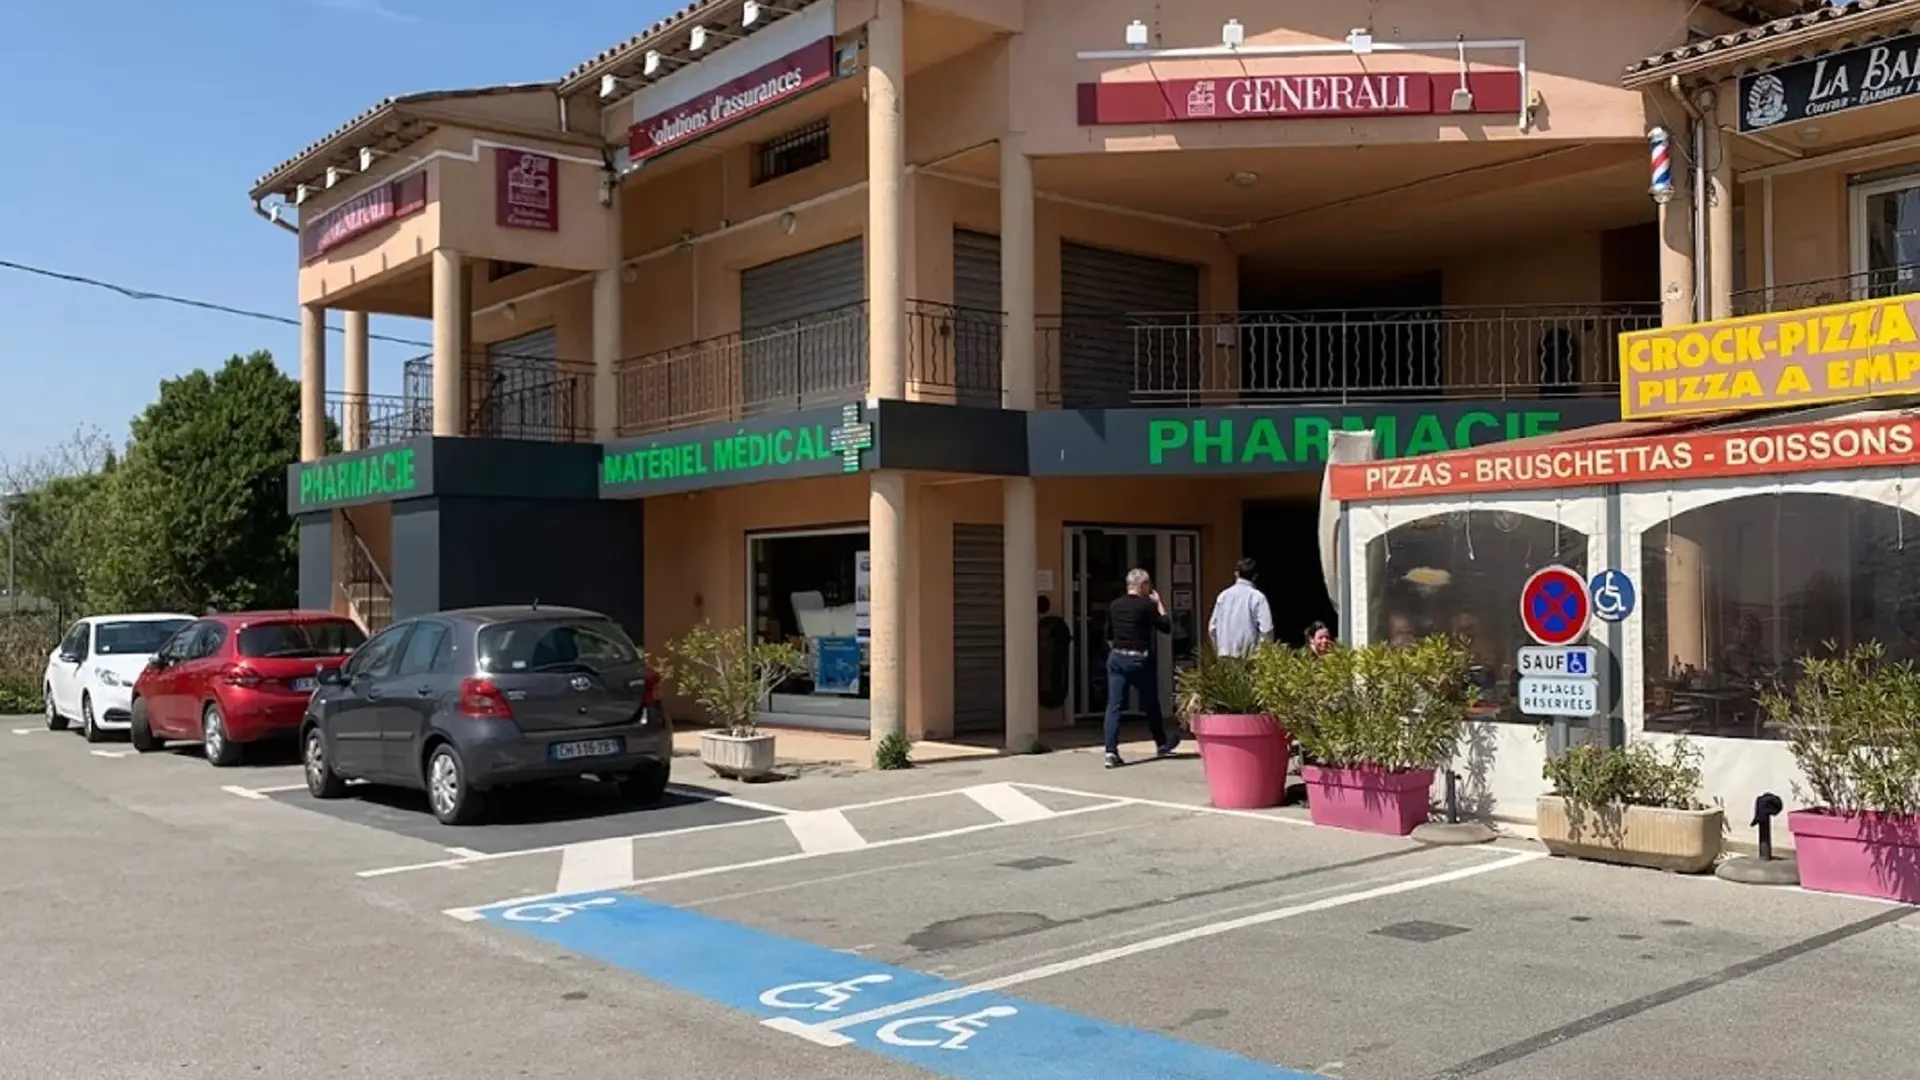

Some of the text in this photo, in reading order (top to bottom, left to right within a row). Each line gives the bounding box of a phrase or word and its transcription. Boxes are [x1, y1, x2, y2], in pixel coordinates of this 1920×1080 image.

[1226, 75, 1409, 113] GENERALI
[1808, 60, 1849, 100] LA
[648, 67, 802, 146] Solutions d'assurances
[1629, 303, 1917, 373] CROCK-PIZZA
[1639, 369, 1764, 407] PIZZA
[1776, 366, 1812, 395] A
[301, 448, 415, 504] PHARMACIE
[604, 425, 832, 483] MATÉRIEL MÉDICAL
[1366, 462, 1452, 491] PIZZAS
[1476, 441, 1693, 483] BRUSCHETTAS
[1725, 424, 1914, 466] BOISSONS
[1523, 654, 1565, 670] SAUF
[1531, 683, 1585, 695] 2 PLACES
